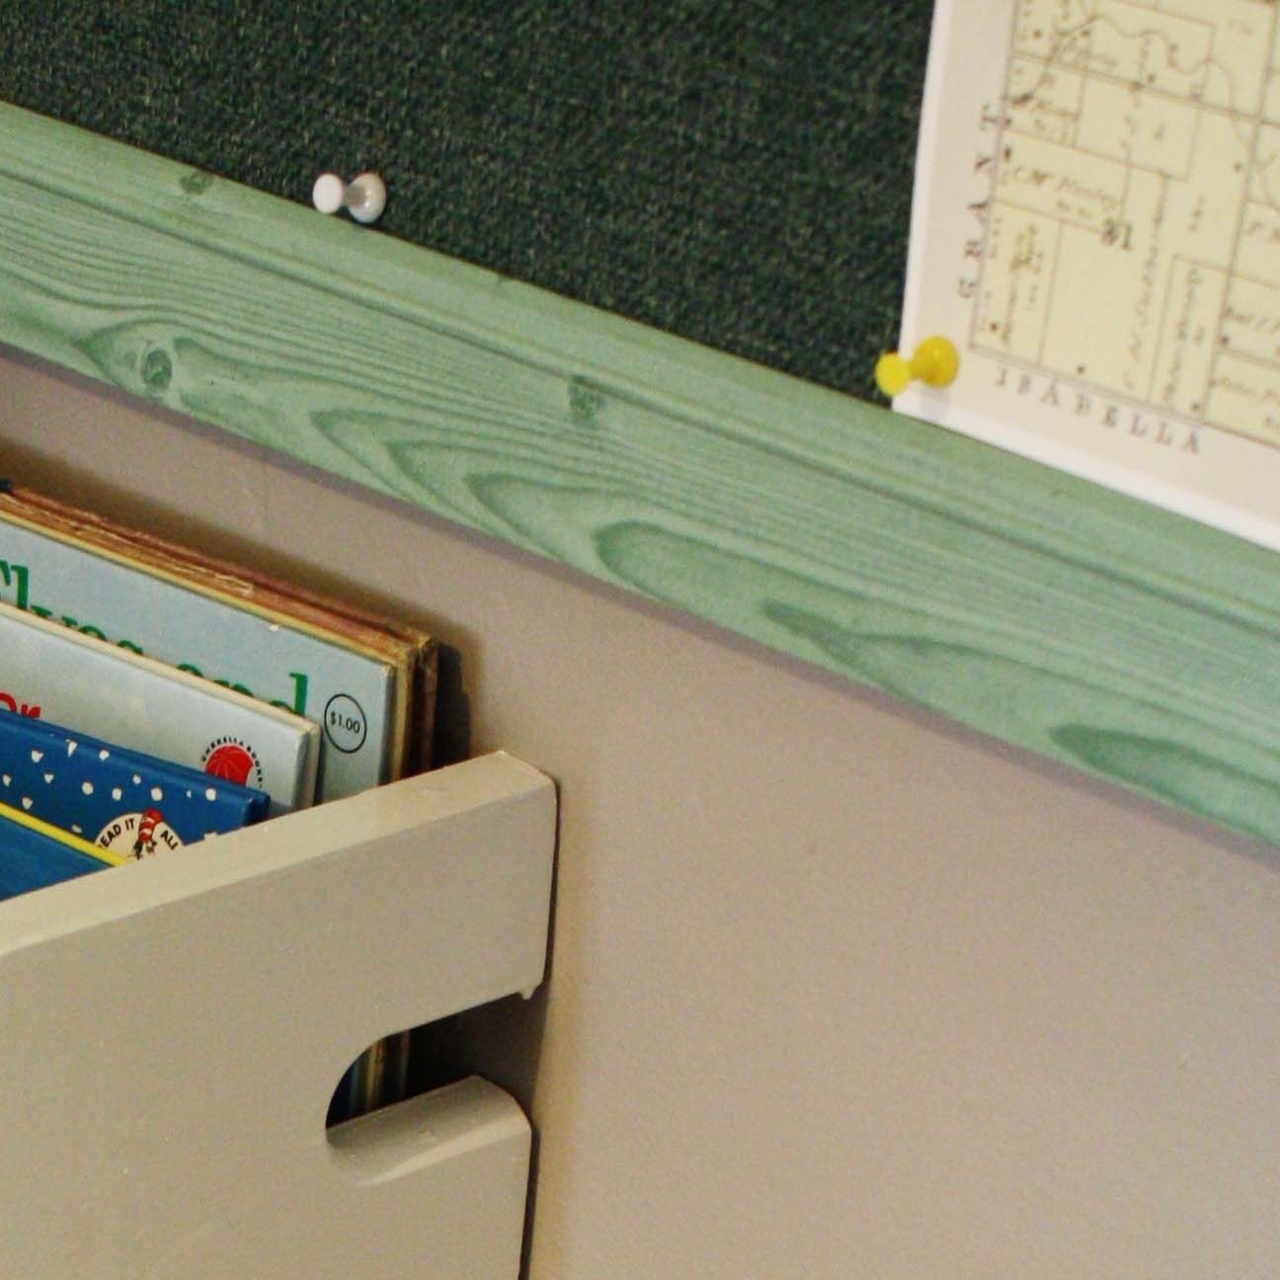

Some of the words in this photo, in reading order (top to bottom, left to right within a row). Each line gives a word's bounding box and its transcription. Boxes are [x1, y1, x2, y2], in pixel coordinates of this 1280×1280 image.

[996, 367, 1200, 454] ISABELLA
[330, 706, 361, 735] $1.00
[97, 823, 122, 850] EAD
[125, 818, 135, 832] IT
